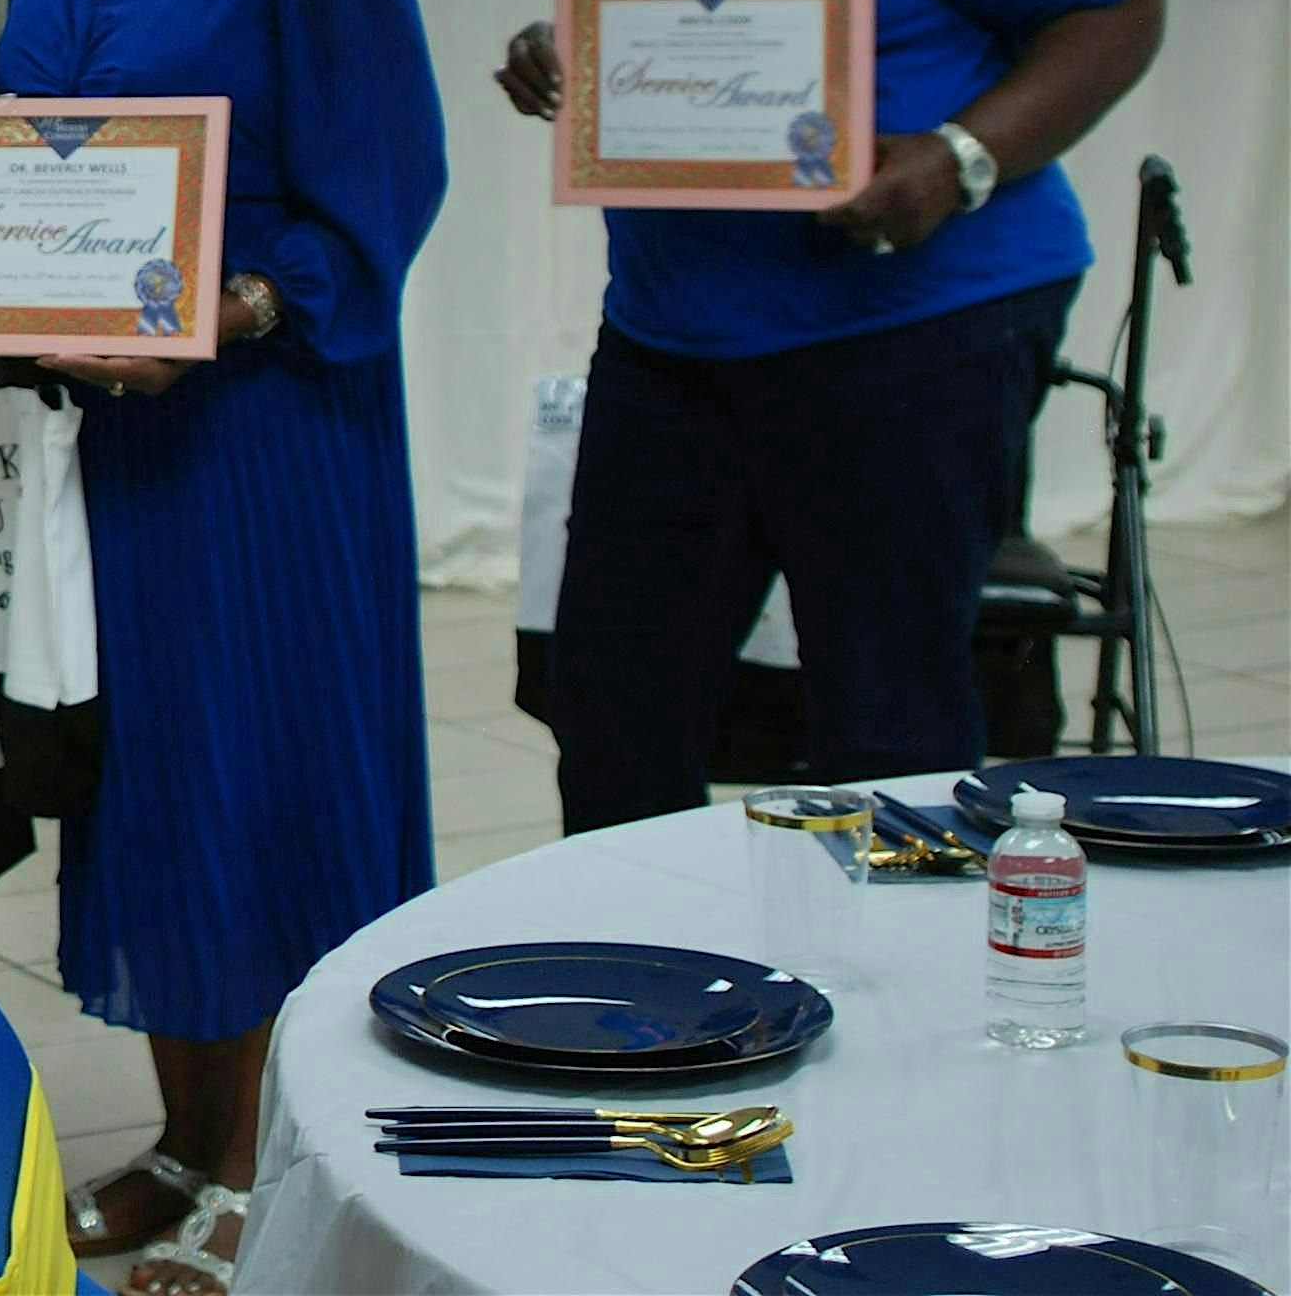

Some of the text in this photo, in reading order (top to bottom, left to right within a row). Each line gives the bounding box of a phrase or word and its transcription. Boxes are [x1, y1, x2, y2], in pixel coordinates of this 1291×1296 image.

[34, 163, 85, 174] BEVERLY
[89, 162, 128, 175] WELLS
[36, 218, 167, 255] Award
